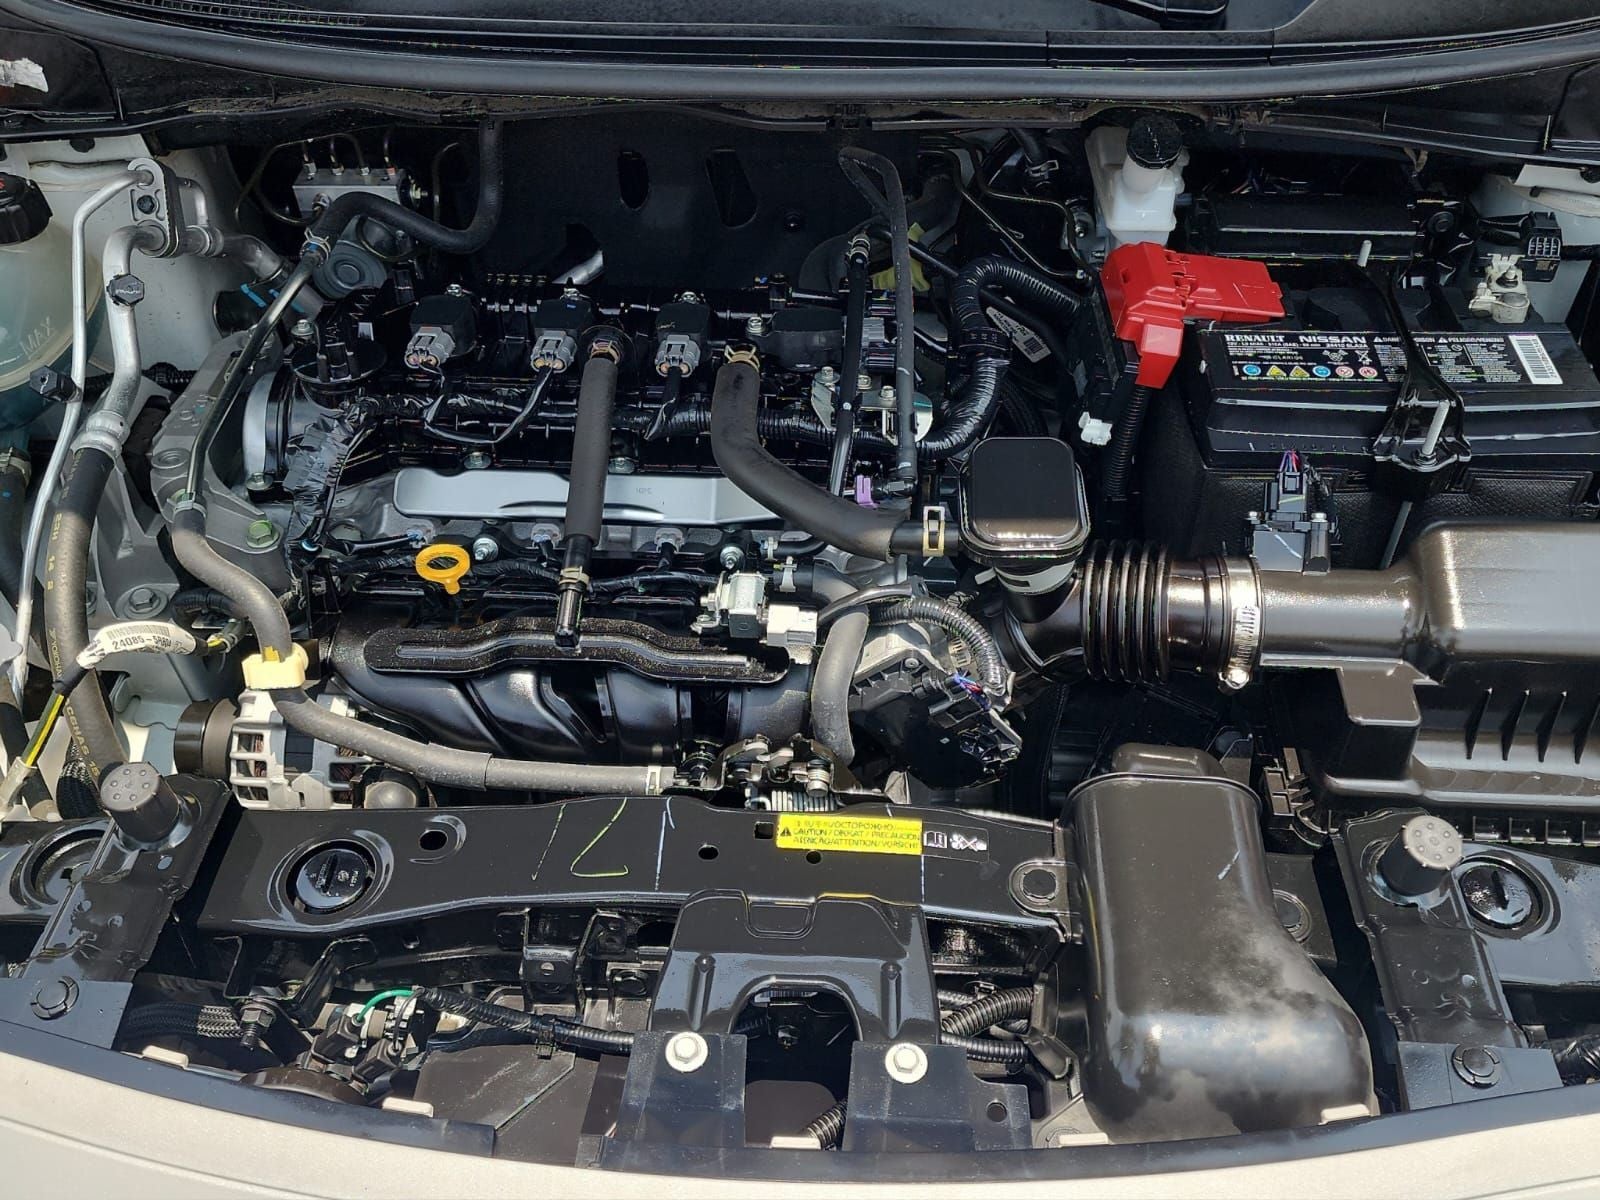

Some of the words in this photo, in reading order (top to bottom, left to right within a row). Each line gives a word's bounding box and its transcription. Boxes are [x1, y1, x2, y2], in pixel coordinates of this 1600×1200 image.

[20, 316, 55, 356] MAX
[1224, 334, 1285, 342] RENAULT
[1299, 335, 1367, 344] NISSAN
[793, 827, 827, 837] CAUTION
